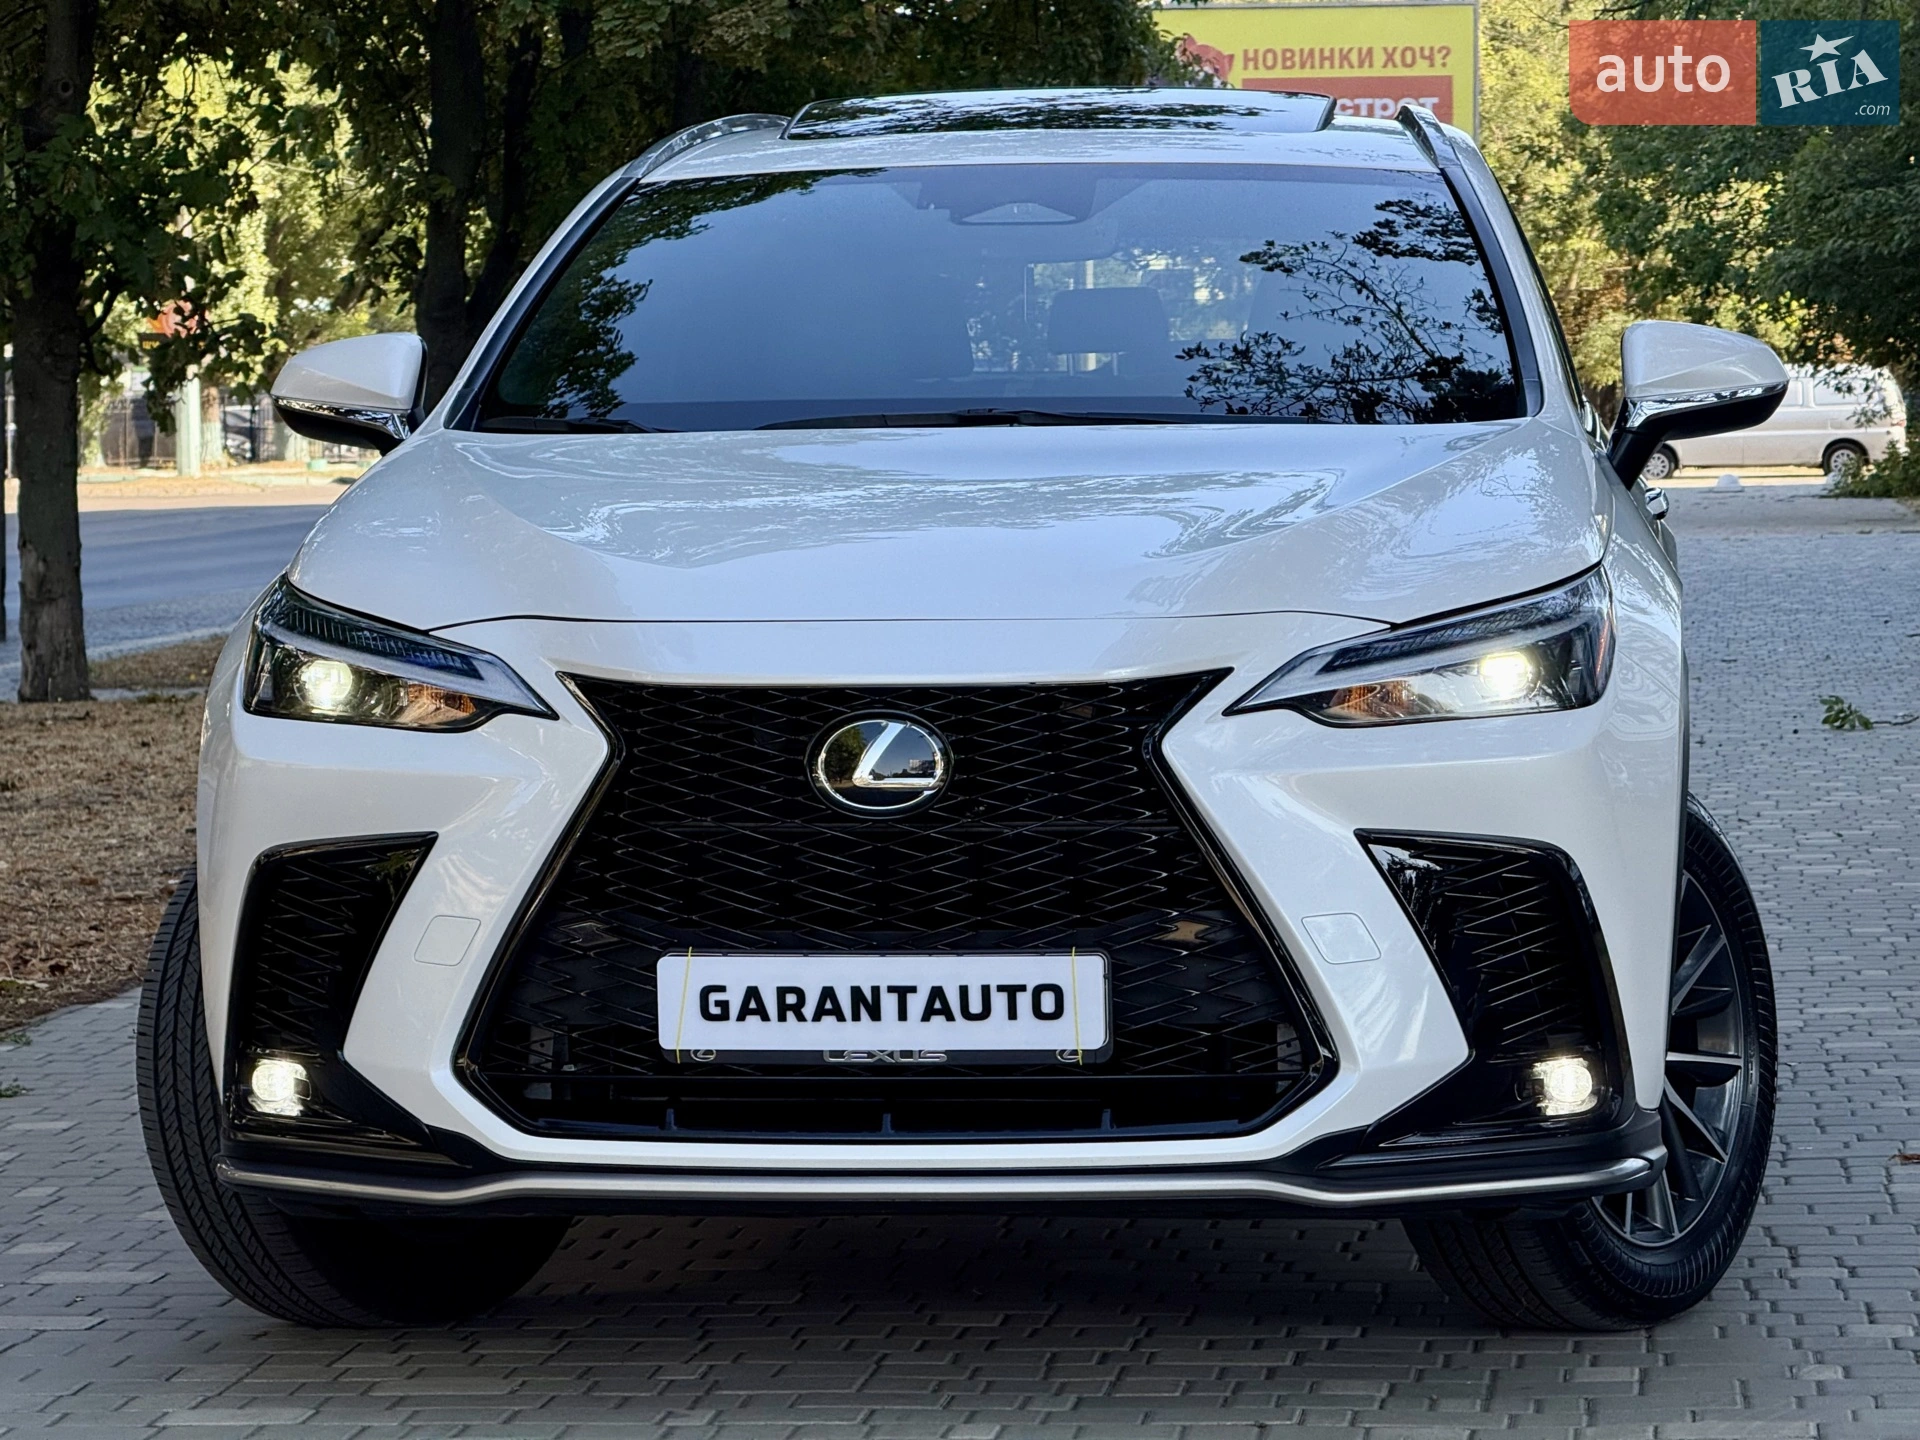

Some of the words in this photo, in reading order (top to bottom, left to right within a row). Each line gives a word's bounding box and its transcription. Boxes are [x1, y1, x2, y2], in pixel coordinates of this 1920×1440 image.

[1242, 46, 1374, 71] НОВИНКИ
[1381, 45, 1452, 68] ХОЧ?
[699, 983, 1065, 1023] GARANTAUTO
[823, 1050, 948, 1063] LEXUS
